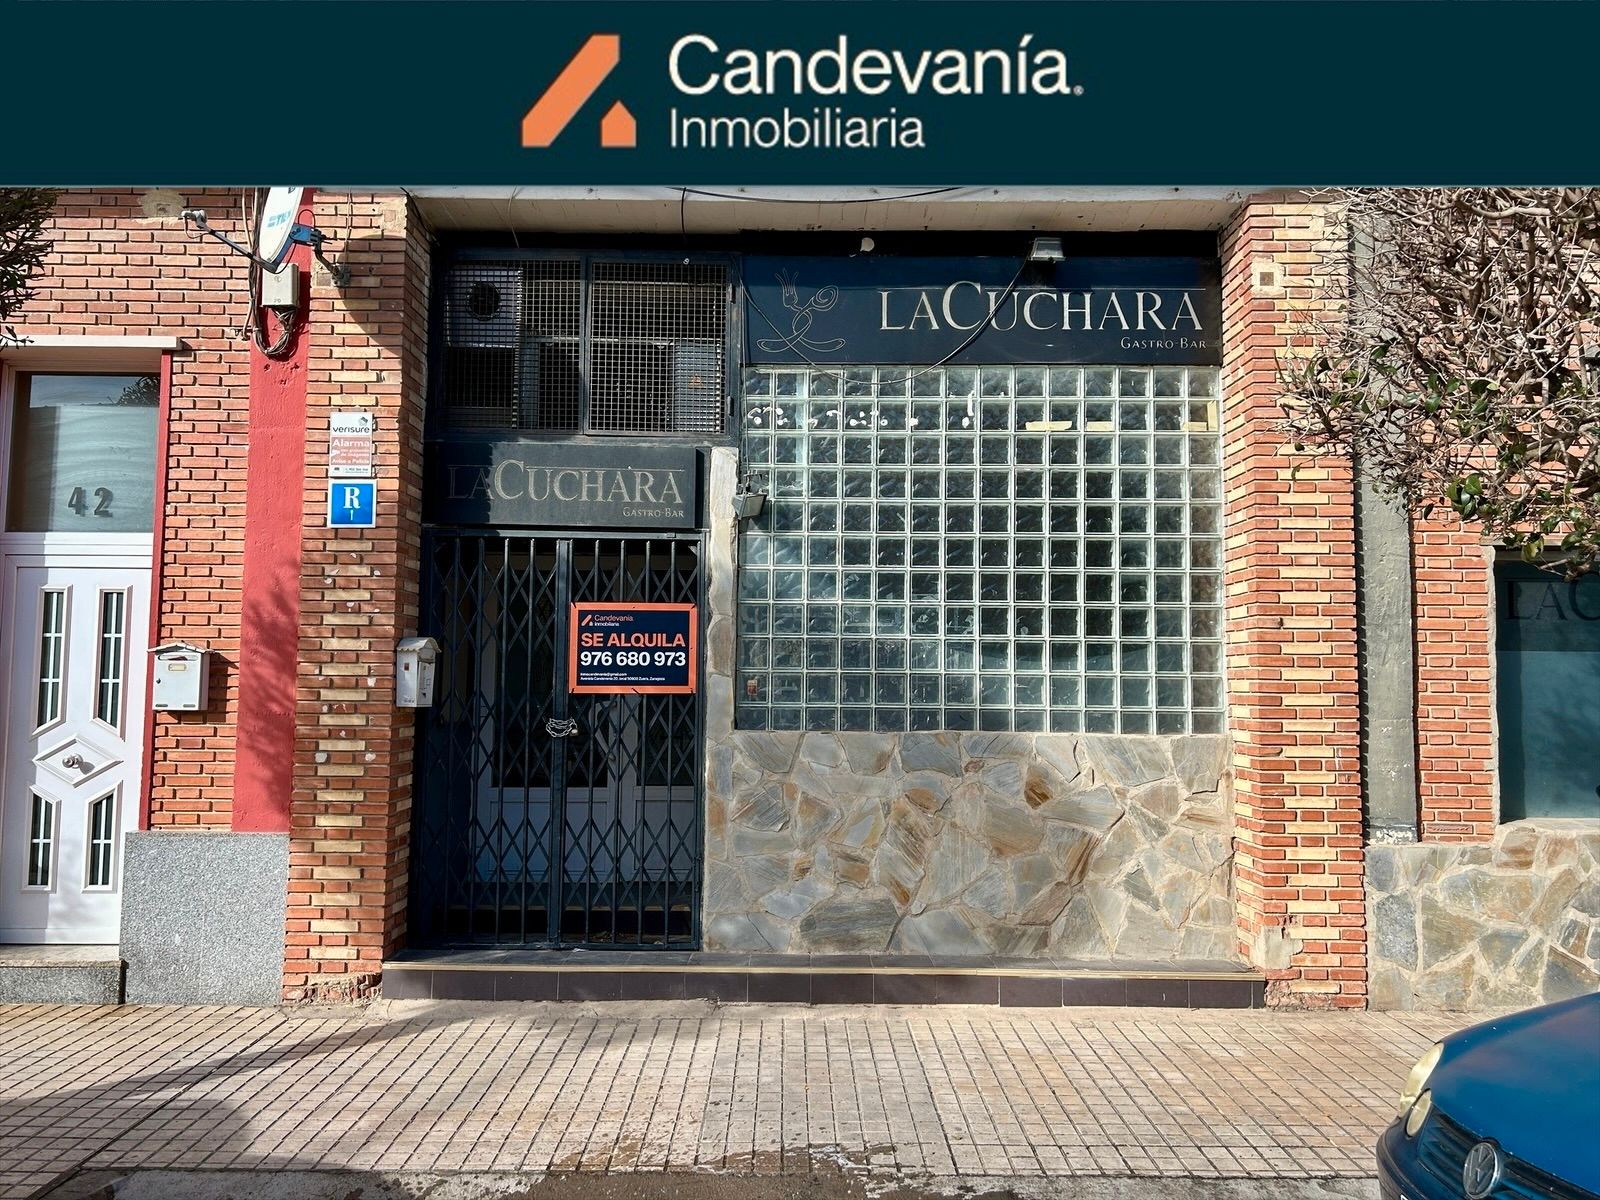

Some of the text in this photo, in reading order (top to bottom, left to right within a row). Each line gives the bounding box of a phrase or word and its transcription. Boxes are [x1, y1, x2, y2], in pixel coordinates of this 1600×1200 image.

[332, 426, 370, 434] verisure
[332, 438, 370, 448] Alarma
[68, 486, 113, 517] 42
[343, 486, 361, 509] R
[581, 632, 686, 648] SE ALQUILA
[580, 651, 686, 667] 976 680 973
